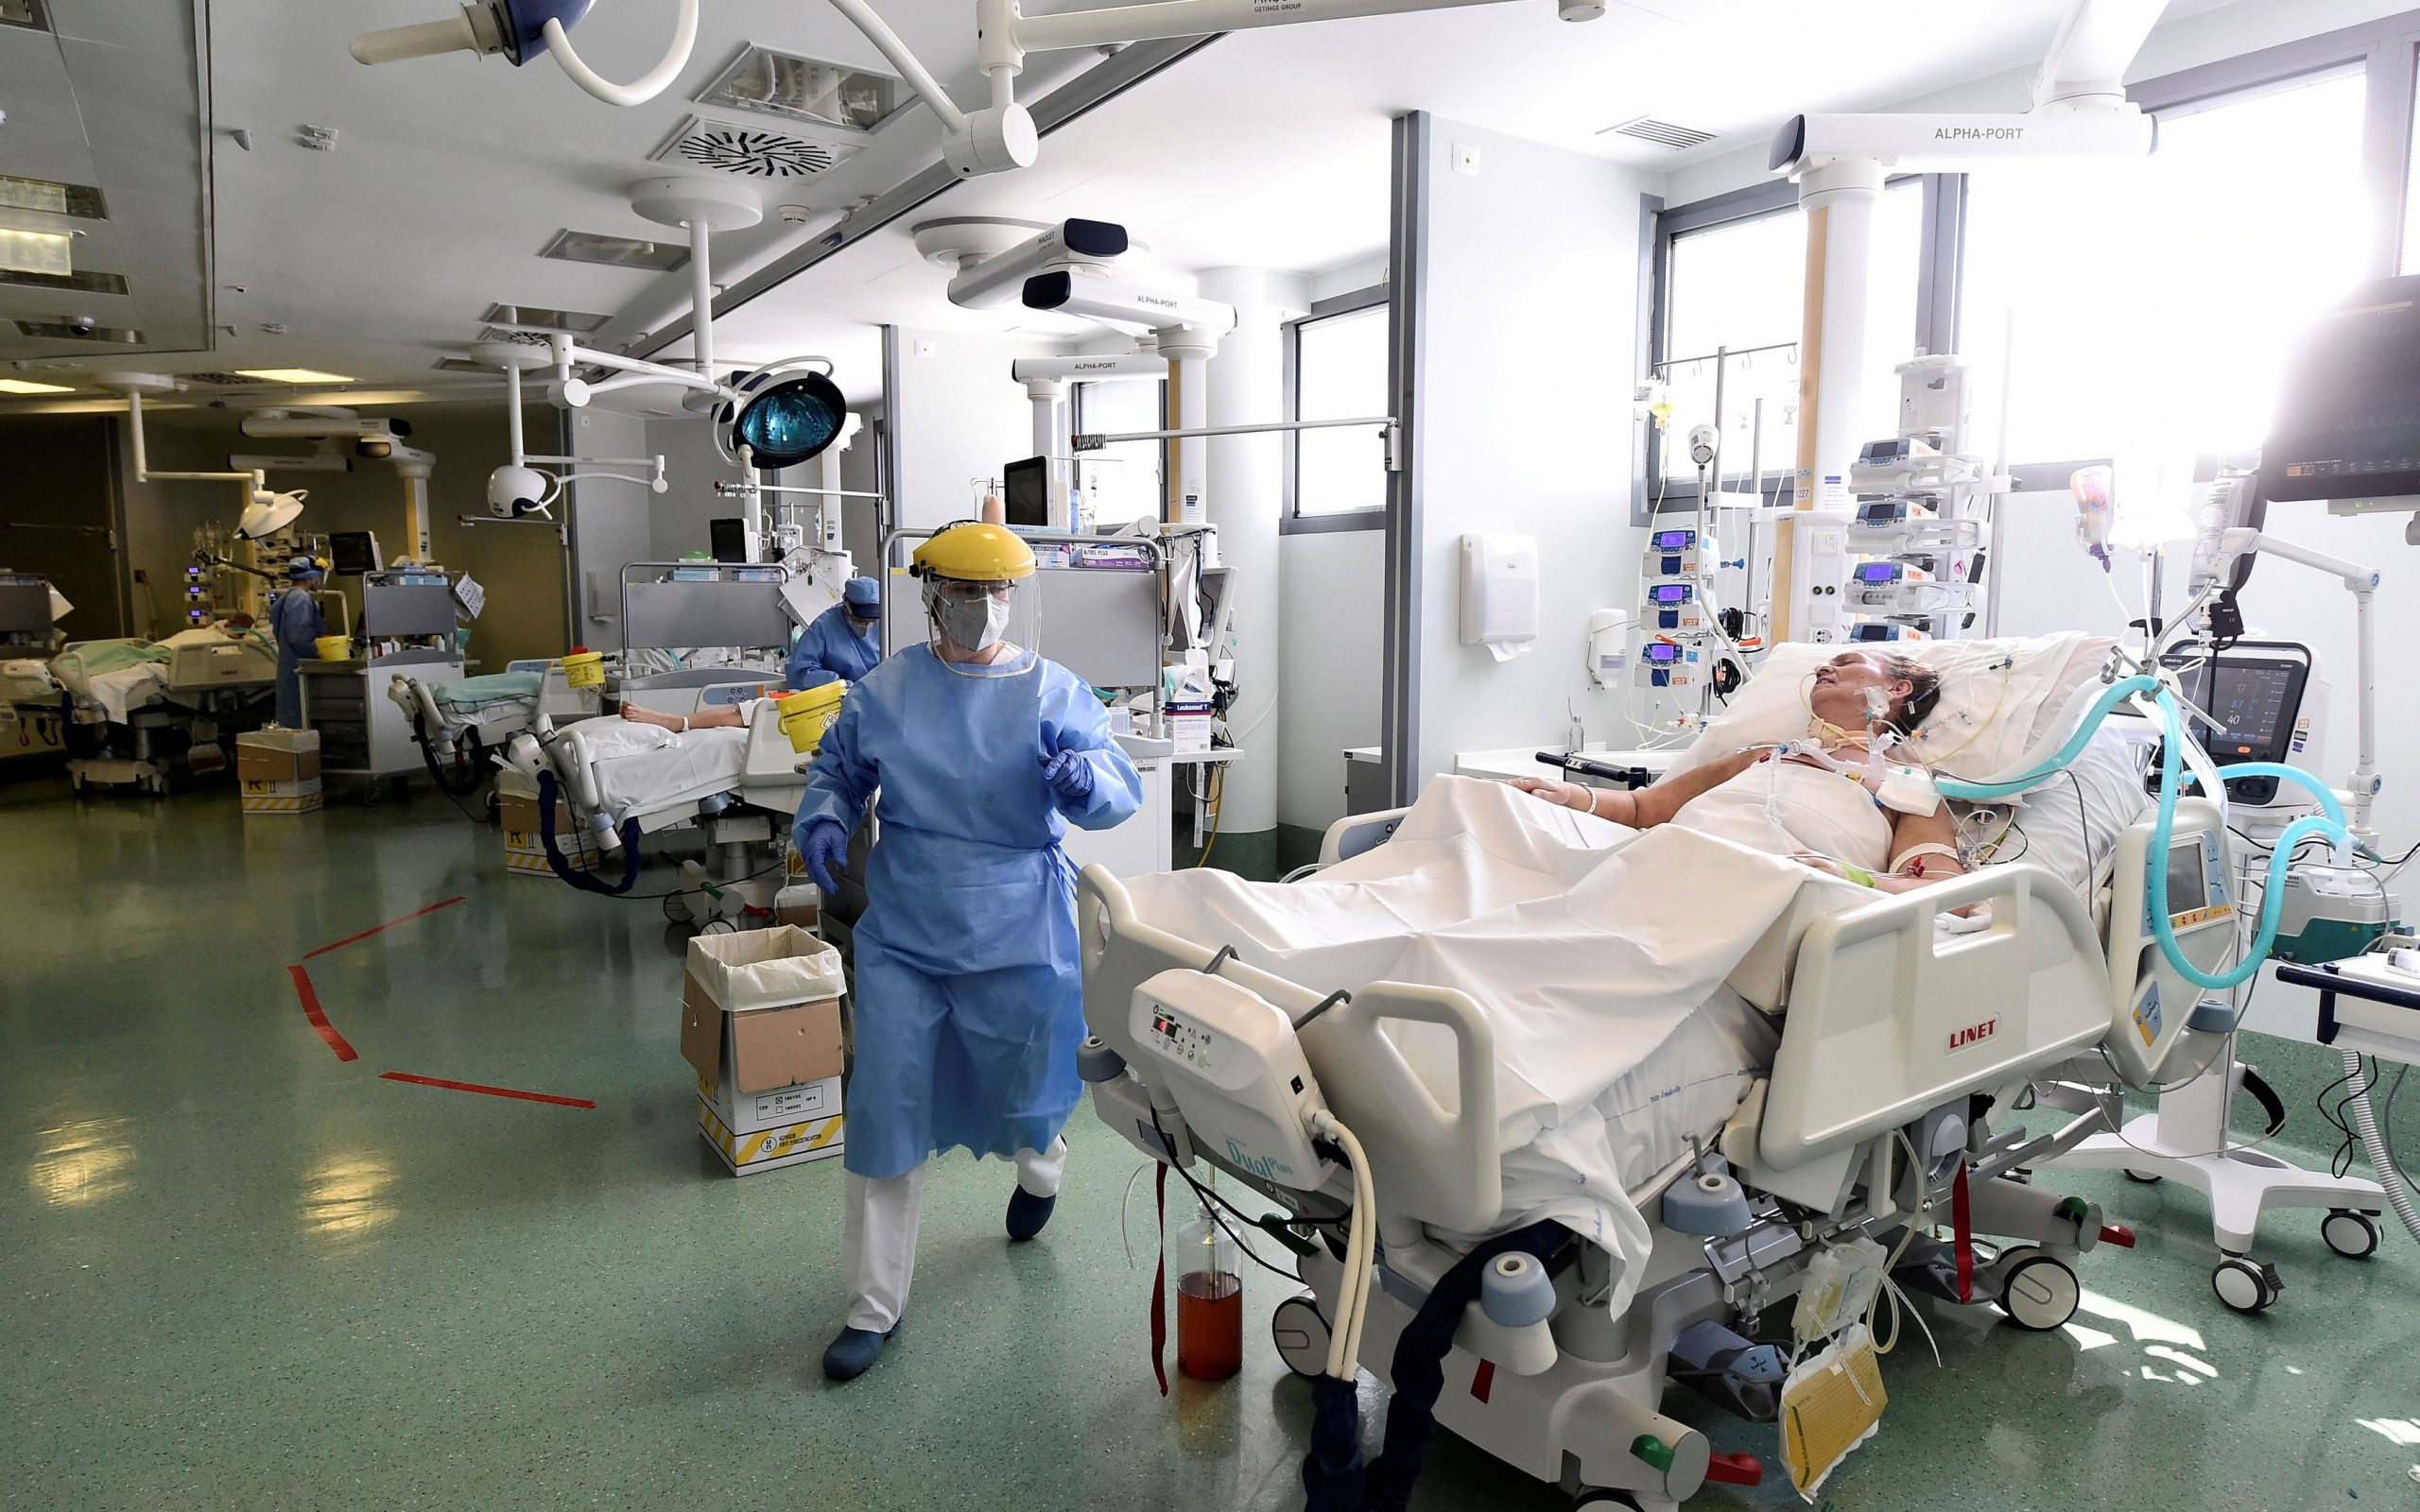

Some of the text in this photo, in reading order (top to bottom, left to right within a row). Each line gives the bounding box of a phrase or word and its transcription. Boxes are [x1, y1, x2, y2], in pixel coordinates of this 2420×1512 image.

[1934, 128, 2024, 140] ALPHA-PORT
[1137, 295, 1178, 309] ALPHA-PORT
[2227, 714, 2240, 725] 40
[1950, 1020, 1996, 1048] LINET
[1225, 1139, 1276, 1181] Dual
